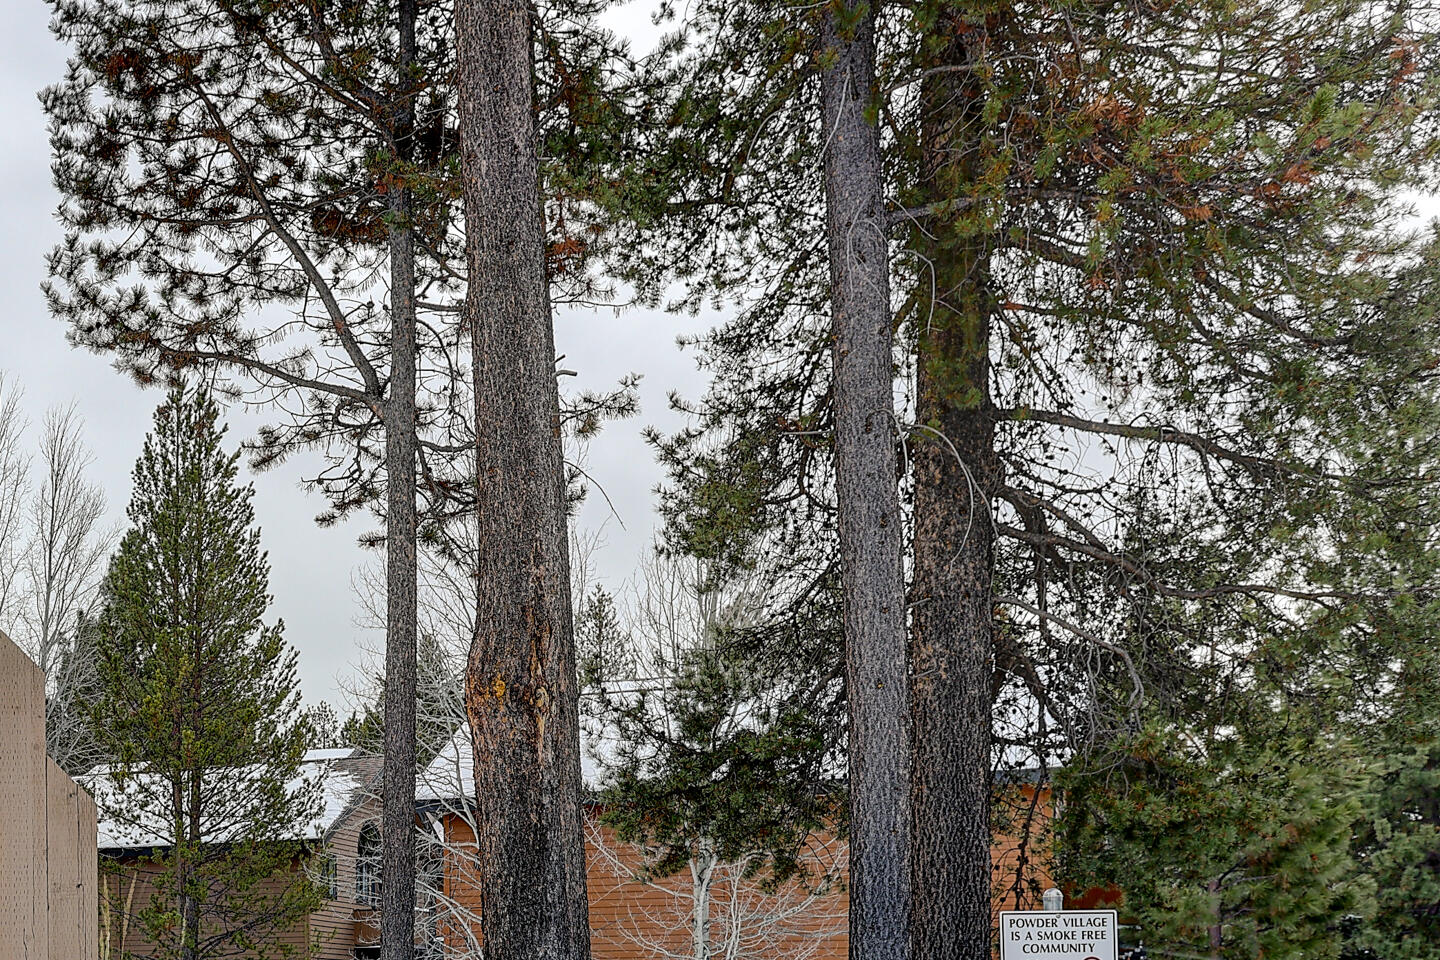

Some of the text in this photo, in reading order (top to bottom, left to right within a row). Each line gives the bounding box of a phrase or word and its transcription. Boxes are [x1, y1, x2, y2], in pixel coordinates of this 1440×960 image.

[1009, 917, 1107, 928] POWDER VILLAGE
[1011, 930, 1106, 941] IS A SMOKE FREE
[1022, 943, 1095, 954] COMMUNITY
